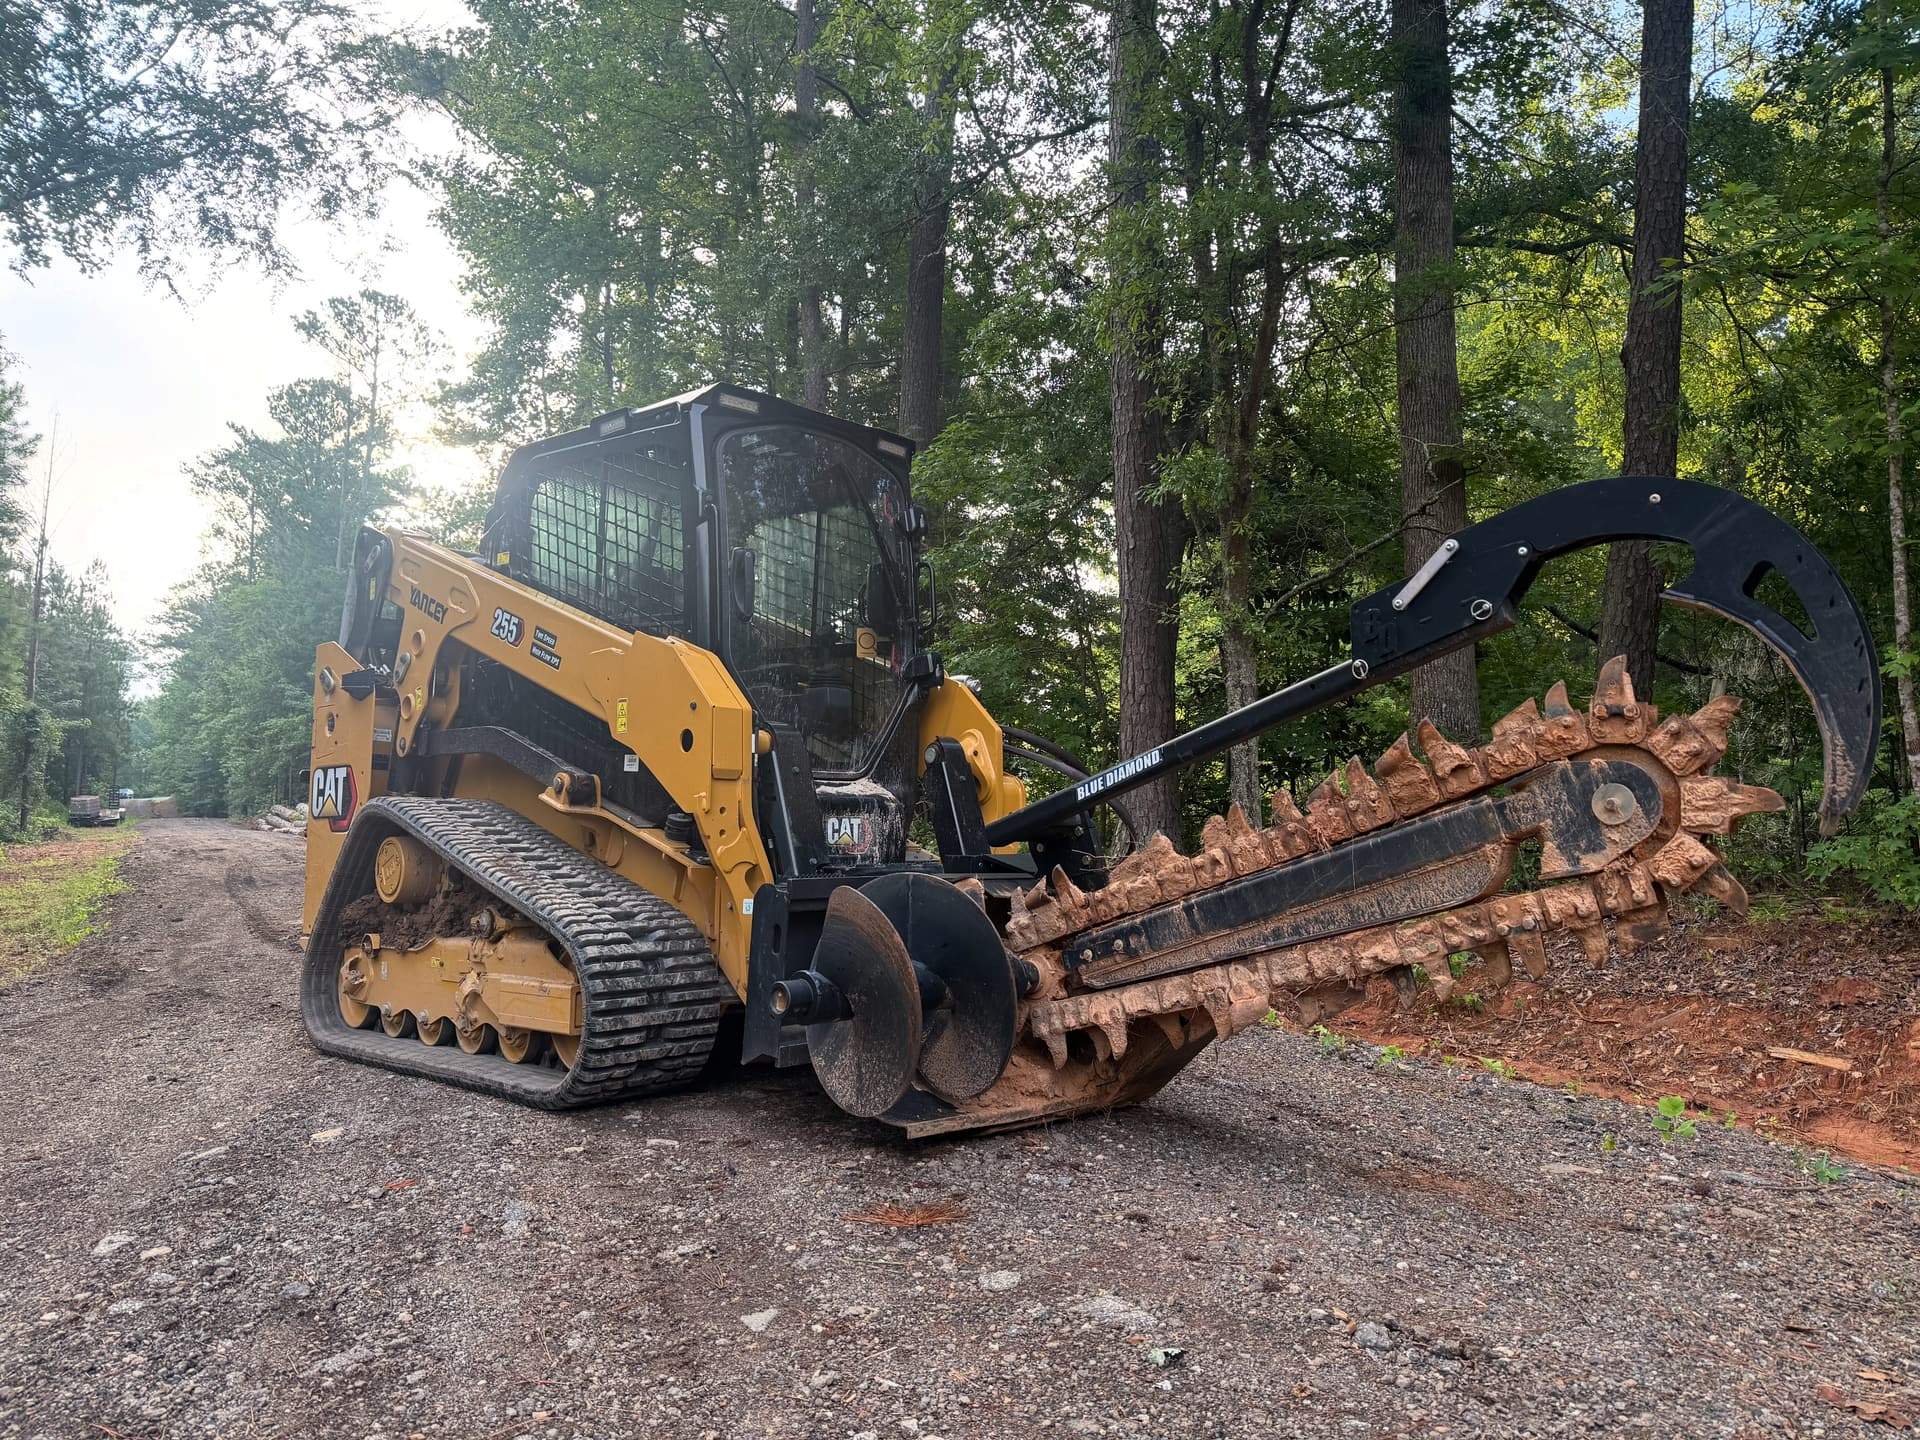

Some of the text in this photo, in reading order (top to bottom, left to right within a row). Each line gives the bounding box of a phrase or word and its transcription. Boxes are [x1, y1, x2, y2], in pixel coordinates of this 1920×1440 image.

[410, 585, 449, 624] YANCEY
[491, 607, 519, 643] 255
[312, 766, 347, 816] CAT
[1077, 749, 1159, 800] BLUE DIAMOND
[827, 817, 861, 844] CAT
